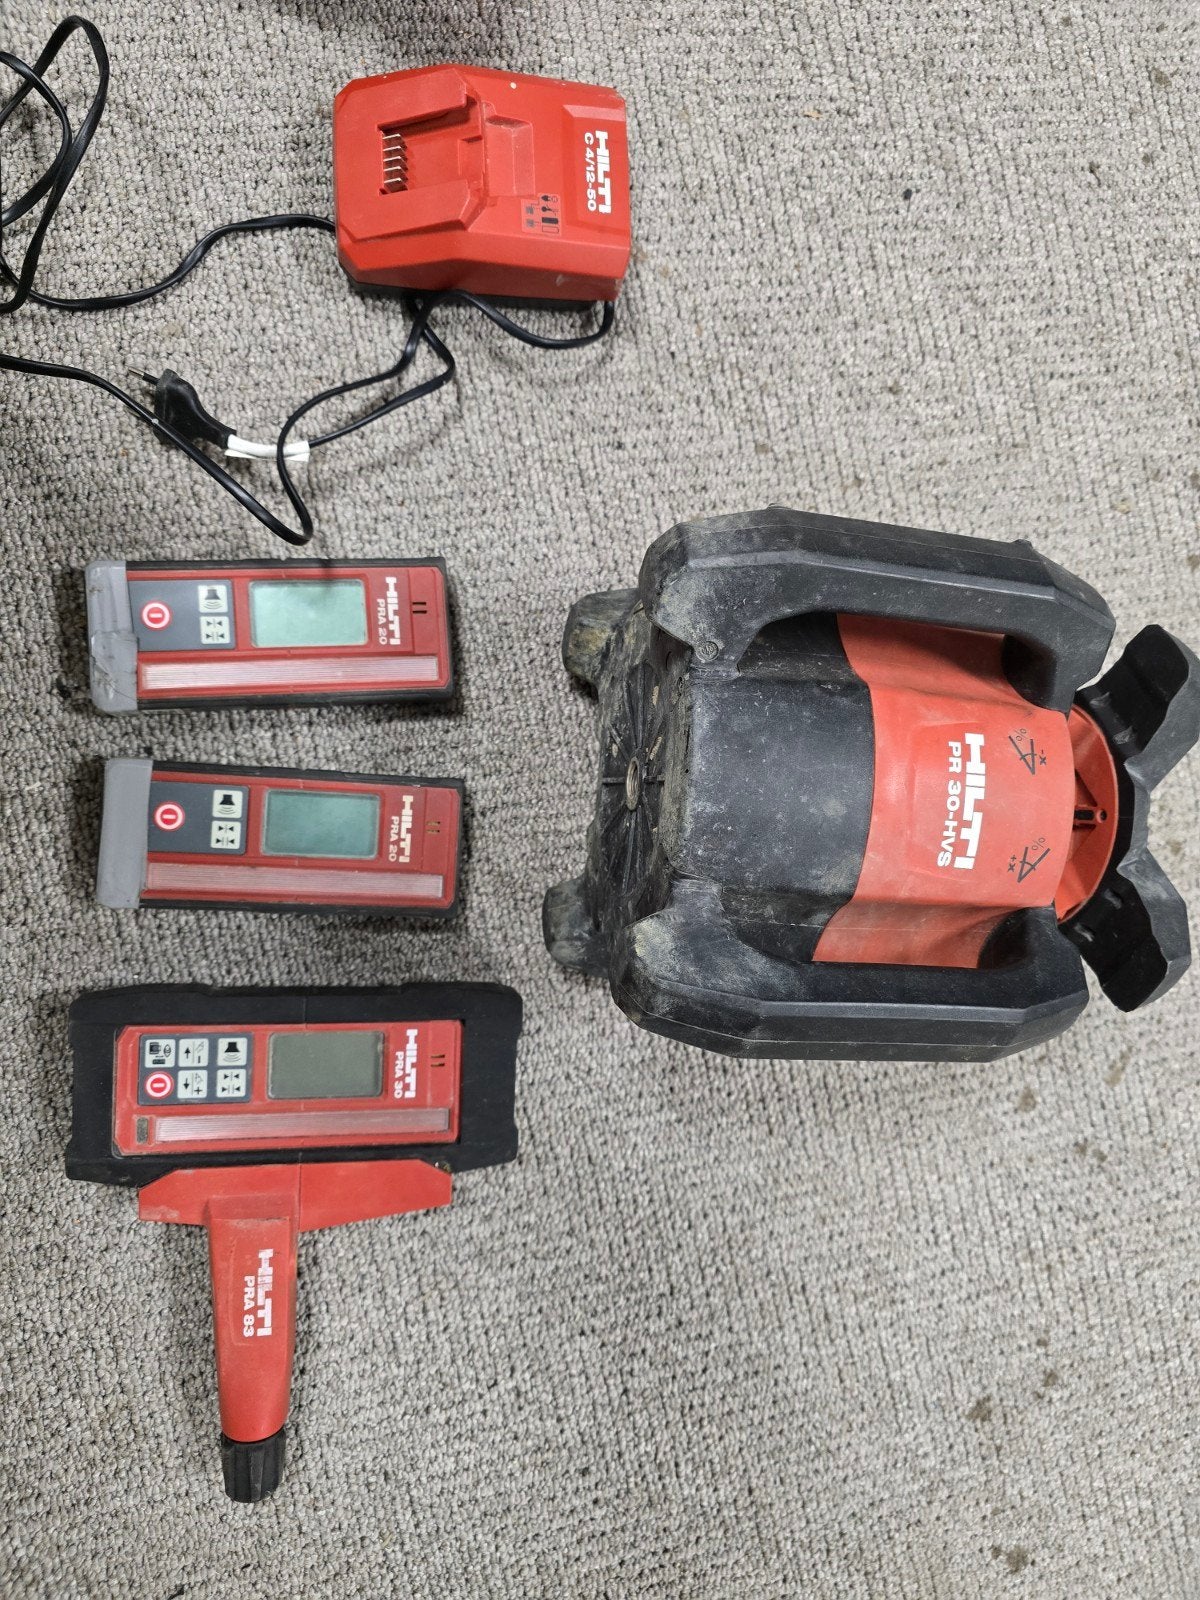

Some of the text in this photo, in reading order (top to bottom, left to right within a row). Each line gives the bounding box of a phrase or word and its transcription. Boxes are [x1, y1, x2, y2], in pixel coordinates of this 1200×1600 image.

[584, 132, 597, 211] C 4/12-50
[595, 130, 612, 213] HILTI
[376, 598, 388, 645] PRA 20
[385, 576, 401, 645] HILTI
[399, 795, 414, 863] HILTI
[937, 741, 962, 867] PR 30-HVS
[954, 733, 986, 870] HILTI
[388, 816, 400, 862] PRA 20
[394, 1051, 405, 1099] PRA 30
[404, 1029, 418, 1098] HILTI
[243, 1275, 256, 1338] PRA 83
[257, 1248, 274, 1337] HILTI
